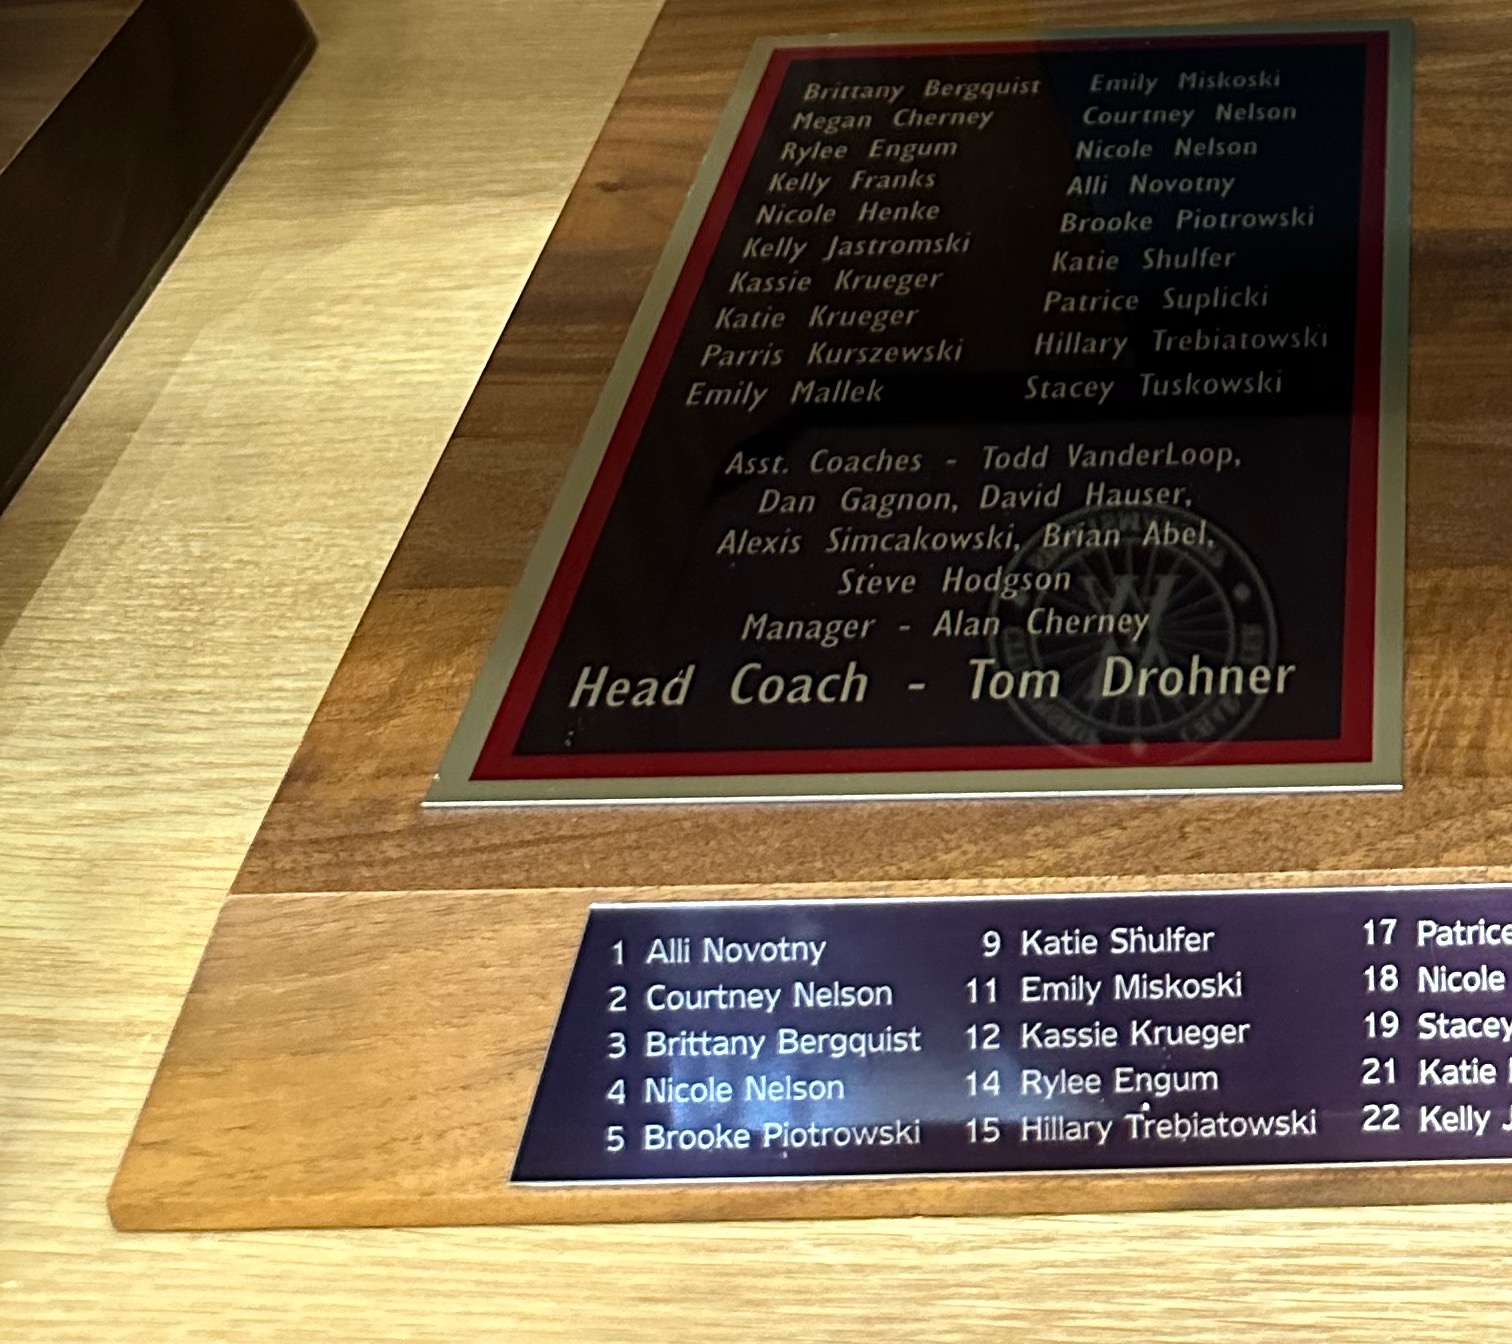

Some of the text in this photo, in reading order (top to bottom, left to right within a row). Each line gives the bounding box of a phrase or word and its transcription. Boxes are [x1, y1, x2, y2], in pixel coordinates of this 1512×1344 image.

[804, 77, 1041, 105] Brittany Bergquist
[1090, 68, 1281, 94] Emily Miskoski
[793, 108, 994, 132] Megan Cherney
[1082, 102, 1297, 129] Courtney Nelson
[781, 137, 958, 163] Rylee Engum
[1076, 136, 1258, 159] Nicole Nelson
[768, 169, 936, 195] Kelly Franks
[1067, 172, 1236, 198] Alli Novotny
[755, 201, 940, 225] Nicole Henke
[1060, 207, 1316, 233] Brooke Piotrowski
[743, 232, 971, 261] Kelly Jastromski
[1052, 247, 1236, 273] Katie Shulfer
[729, 269, 943, 295] Kassie Krueger
[1043, 285, 1268, 316] Patrice Suplicki
[714, 305, 919, 331] Katie Krueger
[700, 339, 963, 367] Parris Kurszewski
[1034, 325, 1328, 362] Hillary Trebiatowski
[685, 378, 884, 411] Emily Mallek
[1025, 371, 1283, 405] Stacey Tuskowski
[726, 449, 789, 476] Asst.
[809, 447, 923, 475] Coaches
[982, 445, 1047, 471] Todd
[1067, 442, 1242, 476] VanderLoop,
[758, 480, 1195, 519] Dan Gagnon, David Hauser,
[717, 518, 1215, 558] Alexis Simcakowski, Brian Abel,
[838, 564, 1071, 599] Steve Hodgson
[742, 614, 876, 648] Manager
[933, 610, 1000, 638] Alan
[1025, 607, 1150, 642] Cherney
[569, 664, 691, 709] Head
[729, 660, 869, 705] Coach
[968, 658, 1061, 701] Tom
[1100, 655, 1296, 697] Drohner
[983, 927, 1215, 958] 9 Katie Shulfer
[1363, 919, 1397, 945] 17
[612, 938, 826, 967] 1 Alli Novotny
[965, 972, 1242, 1005] 11 Emily Miskoski
[1364, 966, 1399, 992] 18
[1418, 966, 1505, 993] Nicole
[608, 981, 893, 1014] 2 Courtney Nelson
[965, 1019, 1250, 1050] 12 Kassie Krueger
[1364, 1011, 1399, 1038] 19
[608, 1027, 922, 1060] 3 Brittany Bergquist
[965, 1068, 1219, 1098] 14 Rylee Engum
[1362, 1058, 1396, 1084] 21
[1419, 1058, 1498, 1085] Katie
[607, 1074, 845, 1104] 4 Nicole Nelson
[966, 1110, 1316, 1145] 15 Hillary Trebiatowski
[1362, 1104, 1399, 1132] 22
[1419, 1106, 1491, 1136] Kelly
[606, 1119, 921, 1152] 5 Brooke Piotrowski
